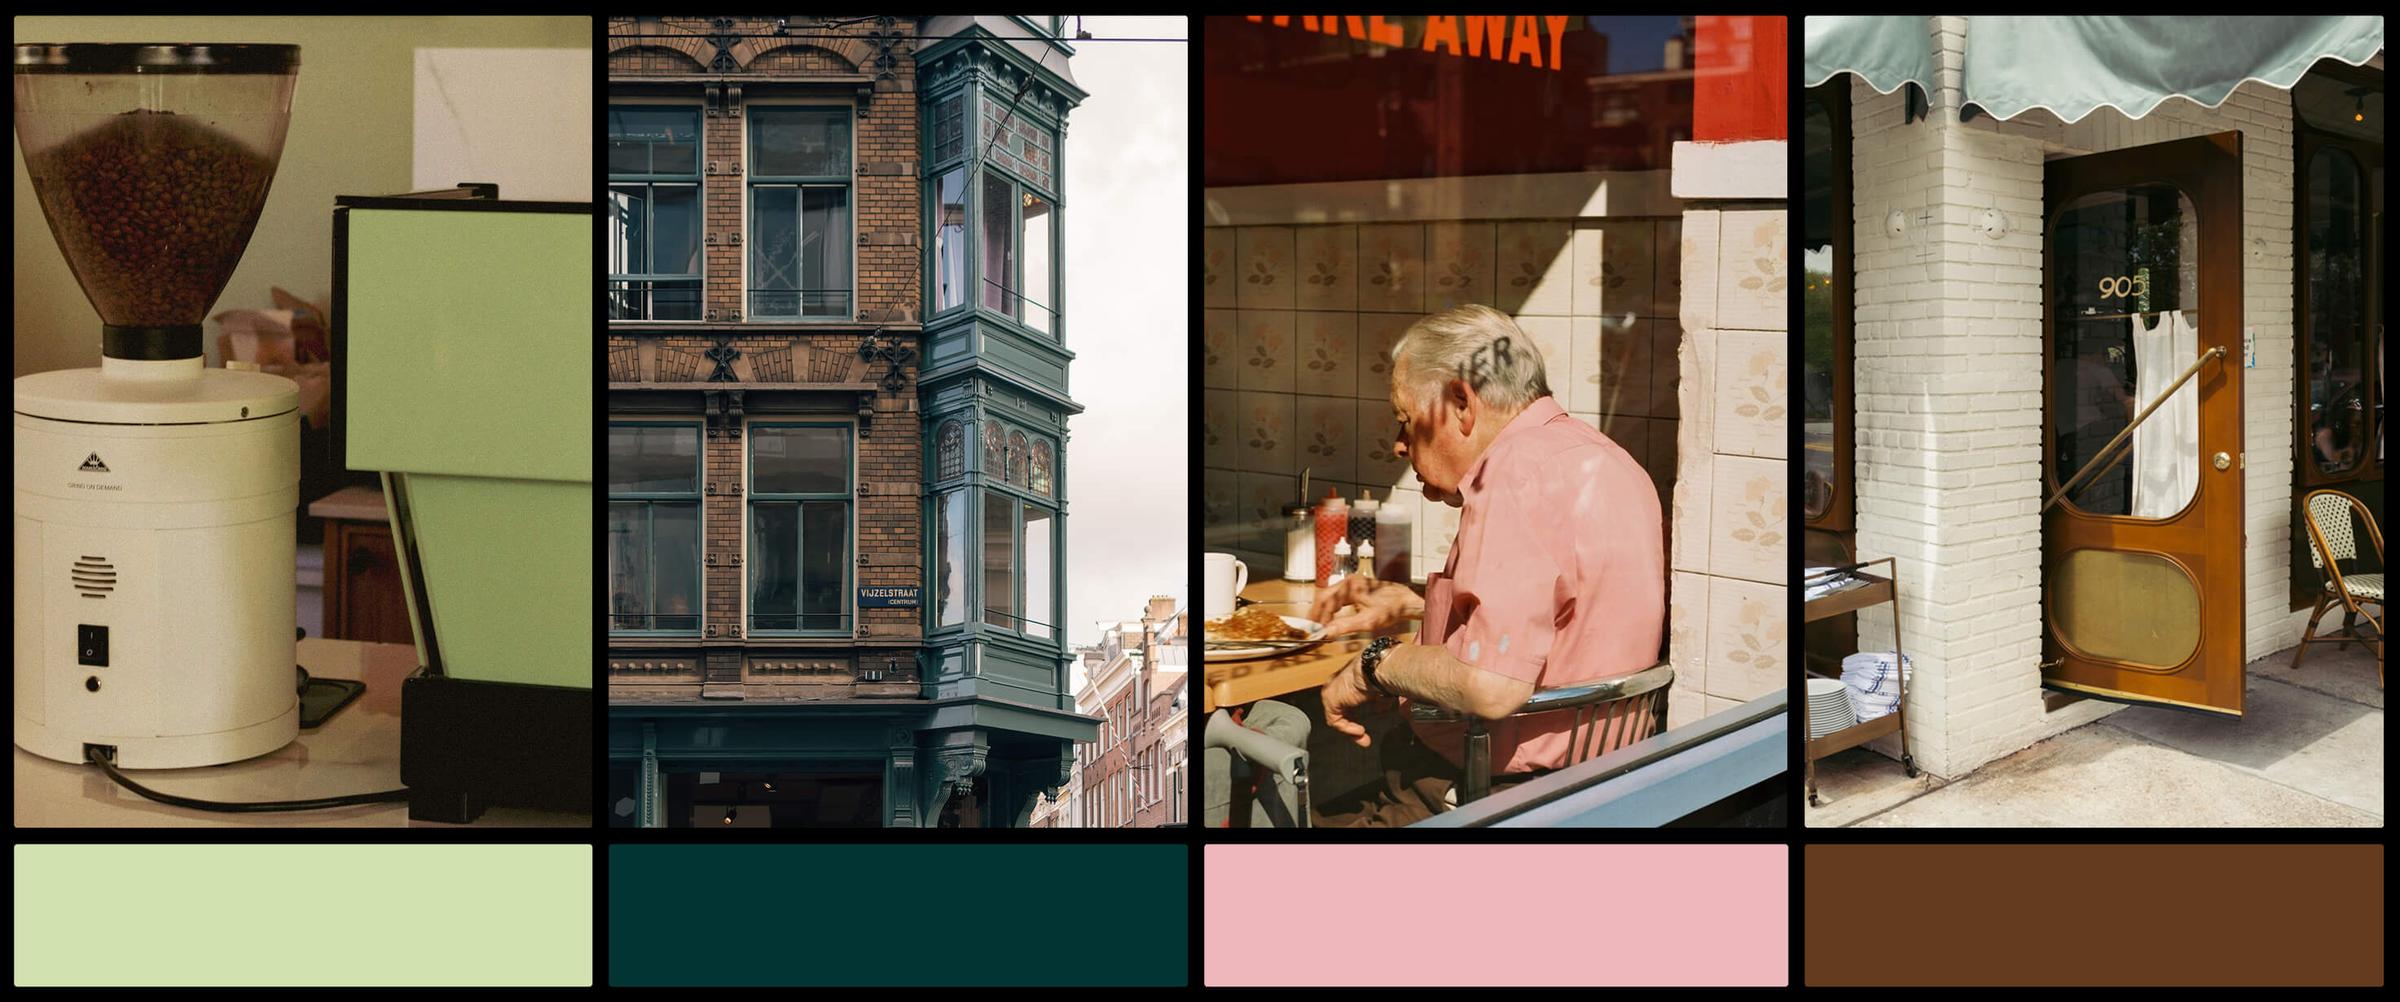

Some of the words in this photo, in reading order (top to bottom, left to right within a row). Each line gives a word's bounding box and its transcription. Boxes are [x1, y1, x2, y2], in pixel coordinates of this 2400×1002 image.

[1422, 16, 1568, 71] AWAY
[2098, 275, 2147, 299] 905
[861, 589, 919, 598] VIJZELSTRAAT
